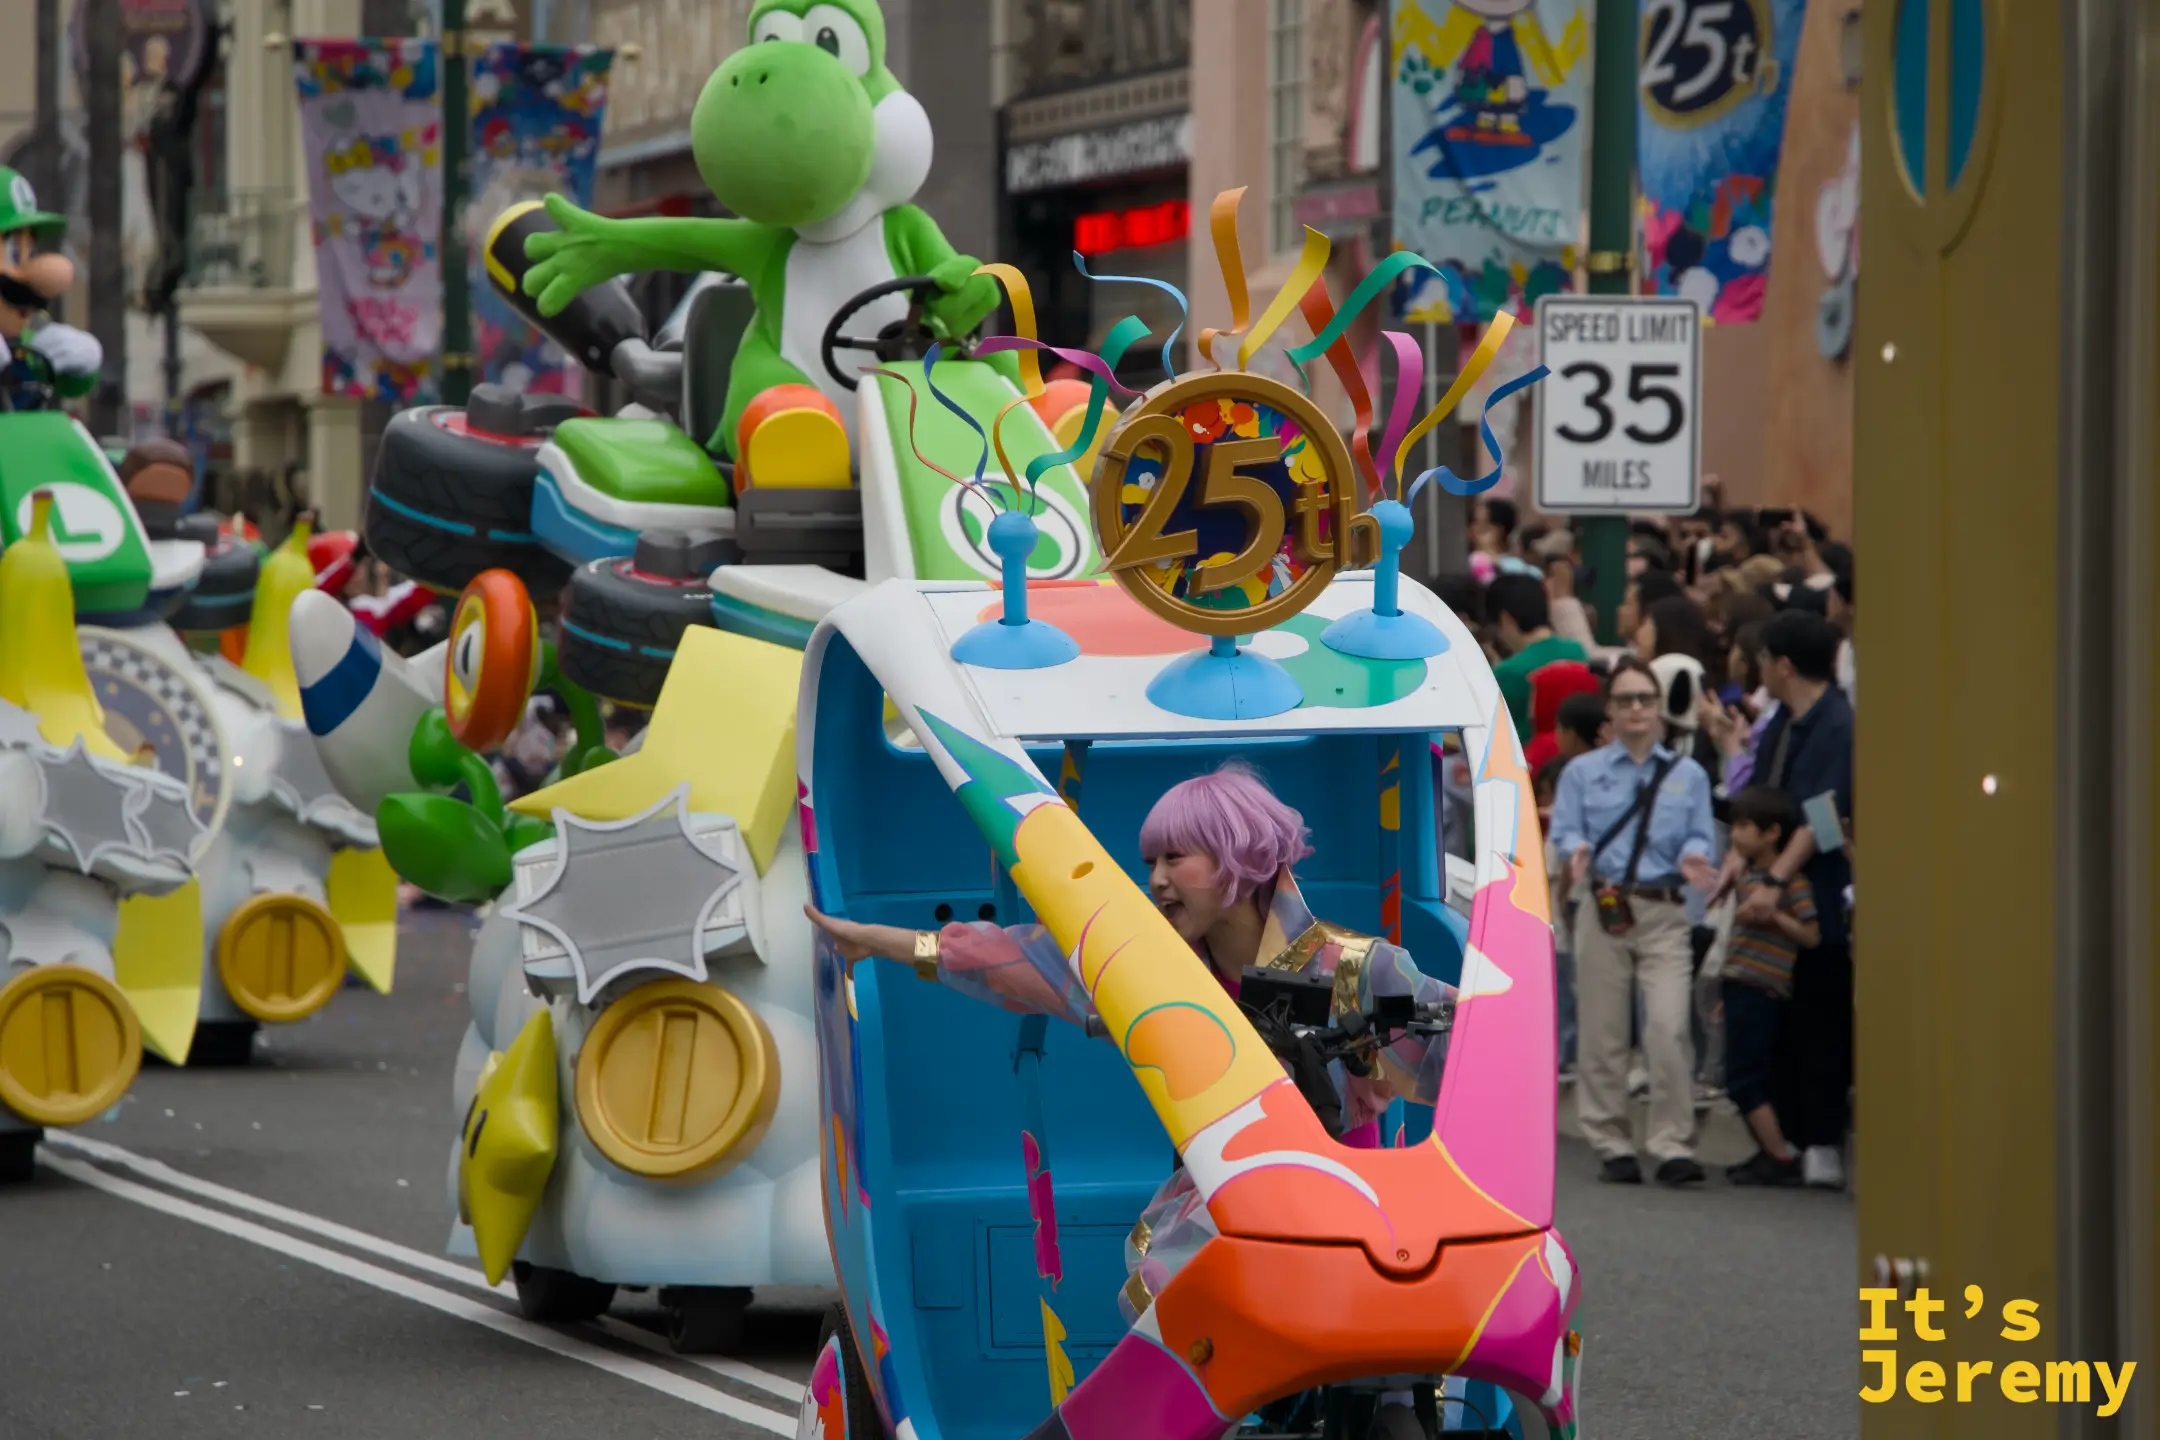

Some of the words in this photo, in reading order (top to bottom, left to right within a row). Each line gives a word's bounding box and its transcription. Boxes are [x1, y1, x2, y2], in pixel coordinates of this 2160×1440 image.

[1639, 0, 1781, 104] 25th
[1550, 313, 1620, 343] SPEED
[1628, 313, 1691, 344] LIMIT
[1555, 360, 1686, 444] 35
[1091, 413, 1382, 596] 25th
[1581, 459, 1652, 489] MILES
